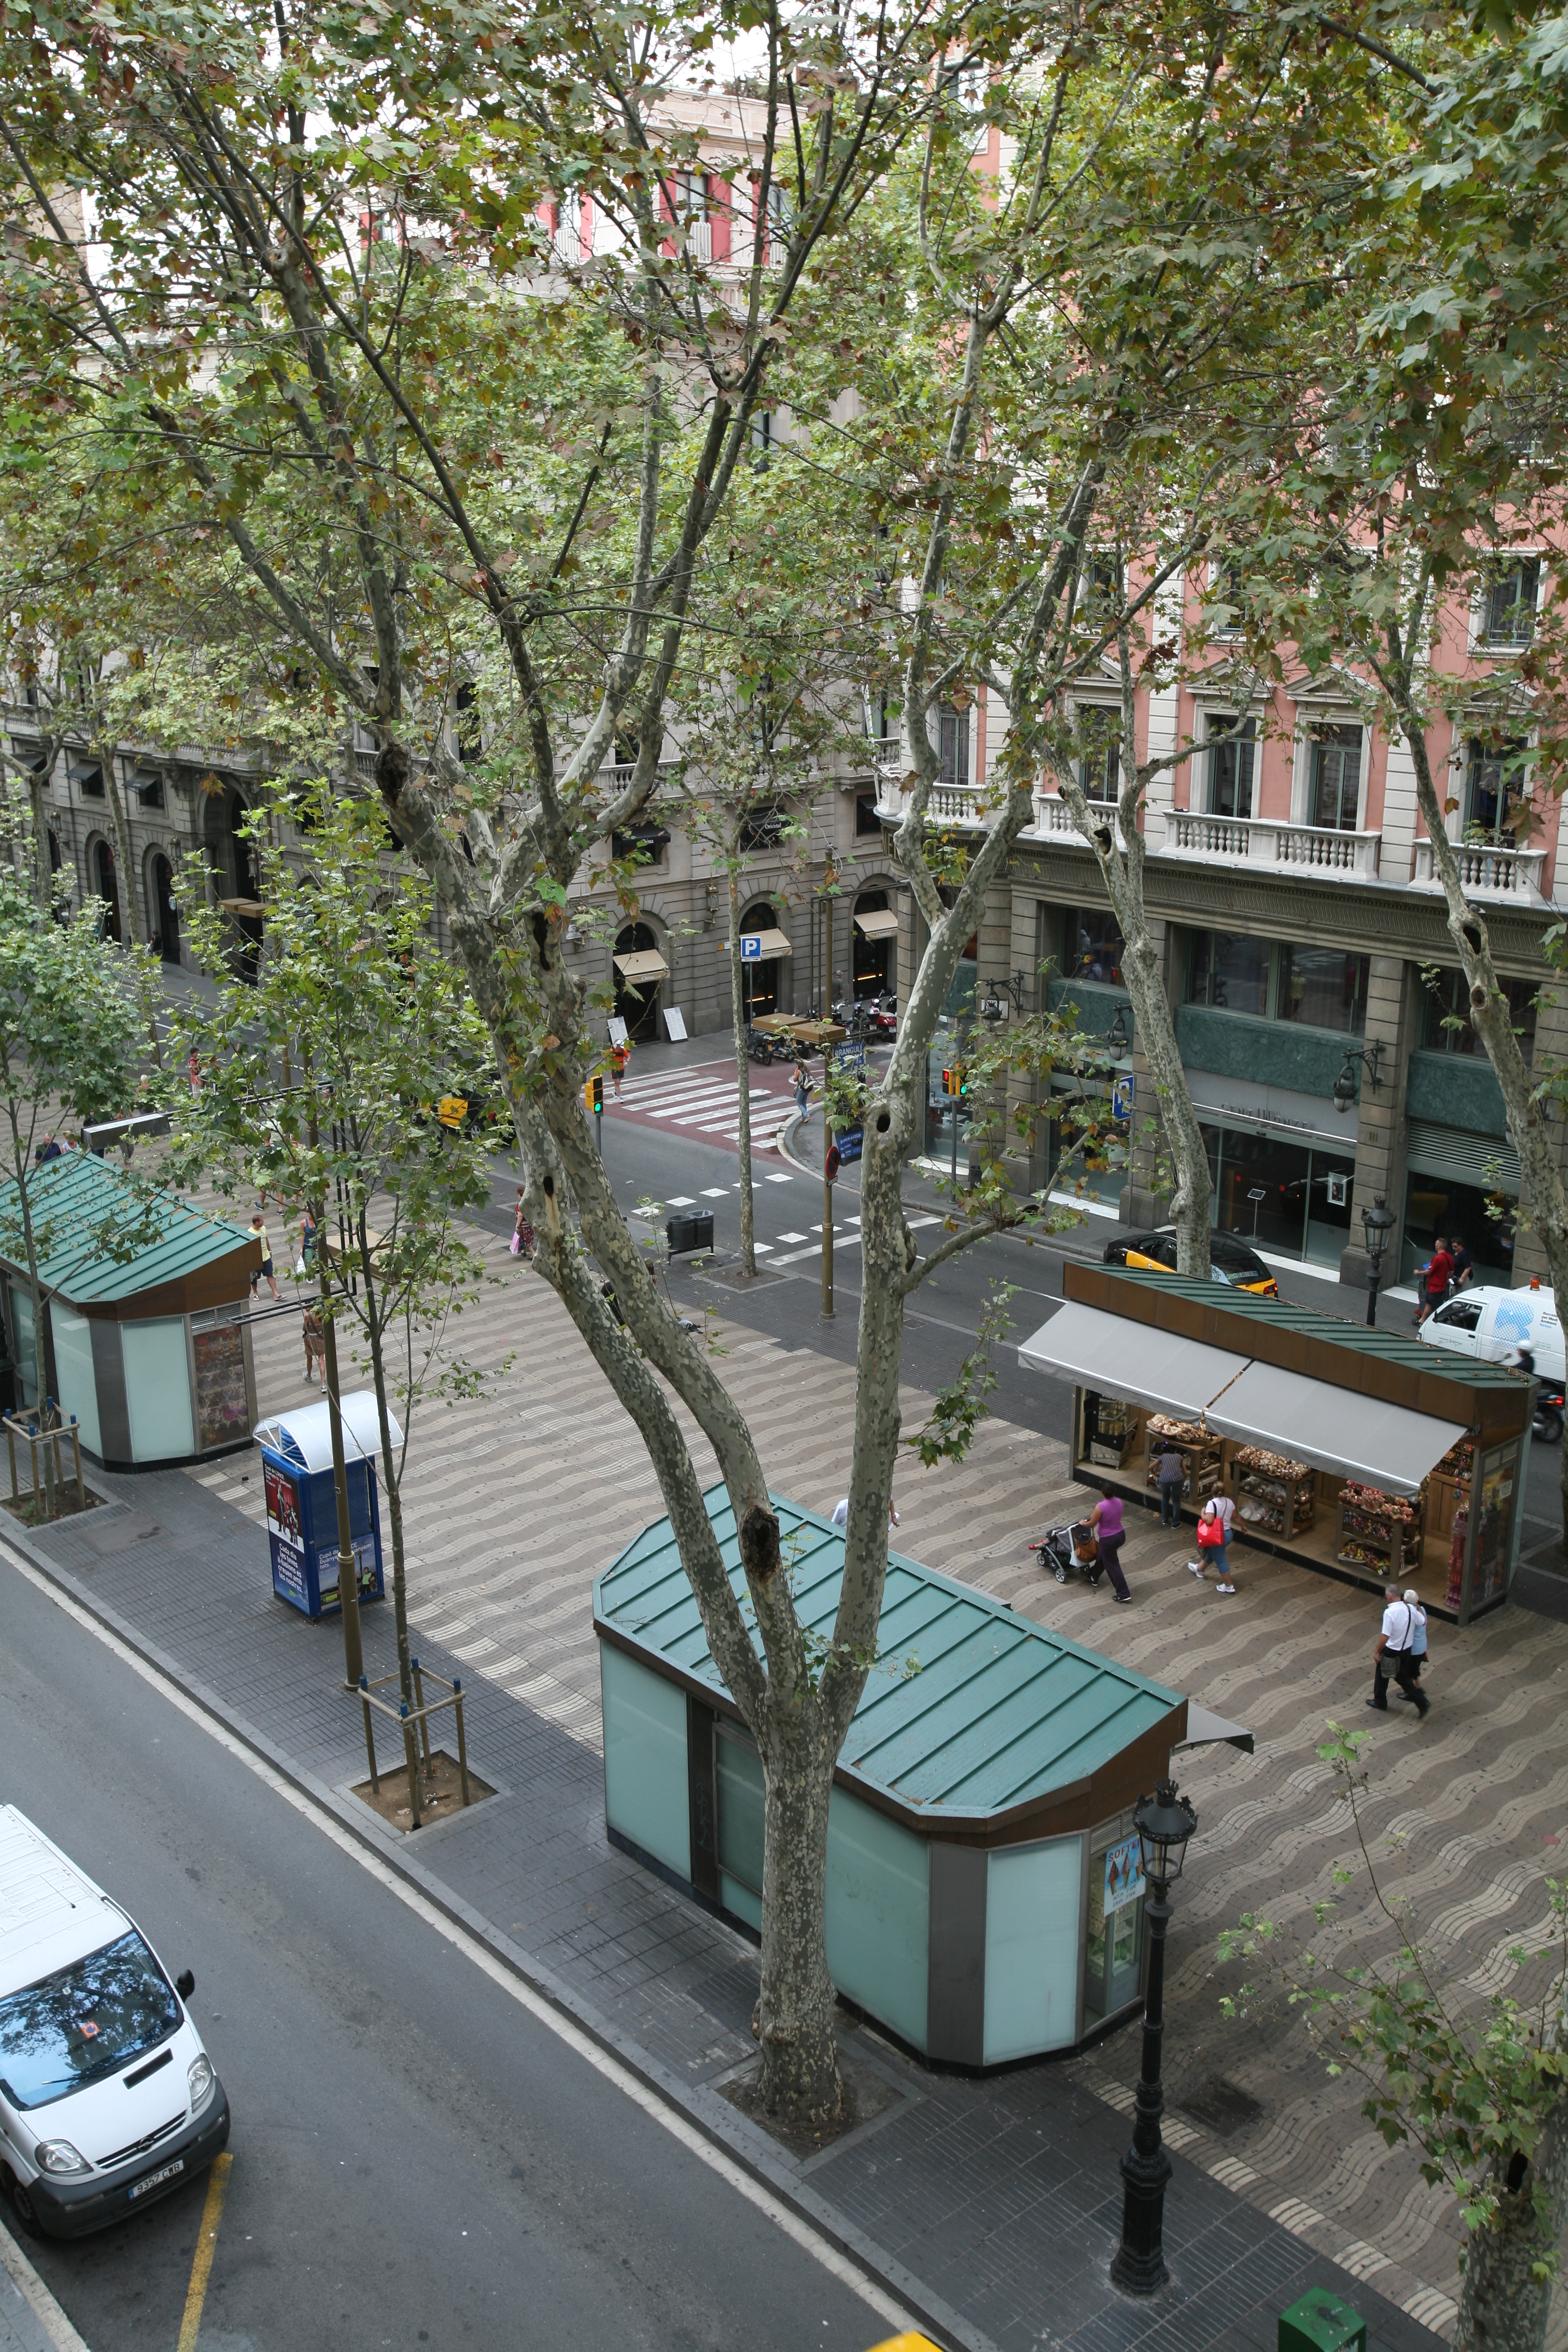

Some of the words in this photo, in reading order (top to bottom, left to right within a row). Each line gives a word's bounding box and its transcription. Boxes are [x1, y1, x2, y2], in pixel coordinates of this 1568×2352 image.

[877, 929, 892, 937] Oriental
[745, 940, 757, 955] P
[279, 1543, 290, 1556] Cada
[352, 1543, 372, 1553] uanyem
[319, 1551, 332, 1560] Cupó
[293, 1575, 303, 1586] amb
[1108, 1838, 1141, 1862] SOFTE
[137, 2173, 160, 2193] 9357
